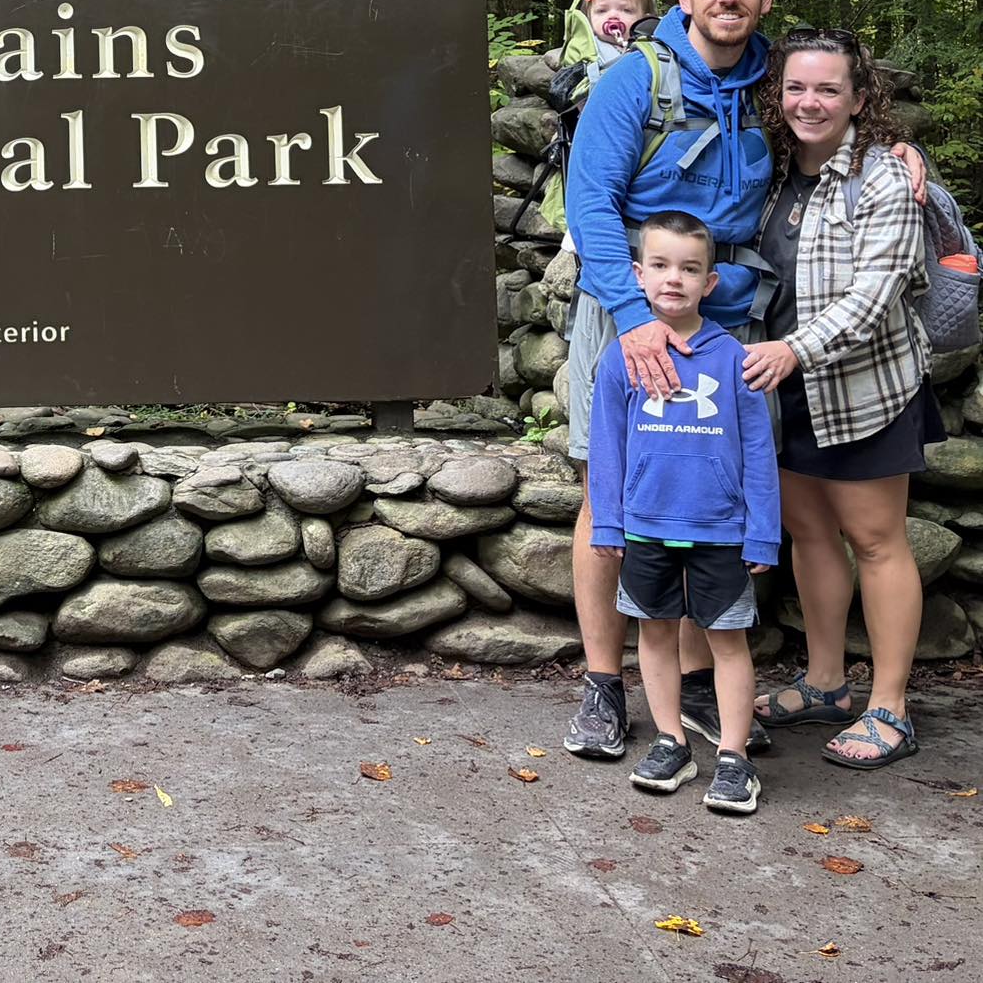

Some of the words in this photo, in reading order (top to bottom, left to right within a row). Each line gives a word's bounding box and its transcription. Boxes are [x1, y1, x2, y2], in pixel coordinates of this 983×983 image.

[131, 106, 382, 188] Park
[659, 168, 718, 188] UNDER
[637, 423, 674, 433] UNDER
[674, 425, 724, 435] ARMOUR
